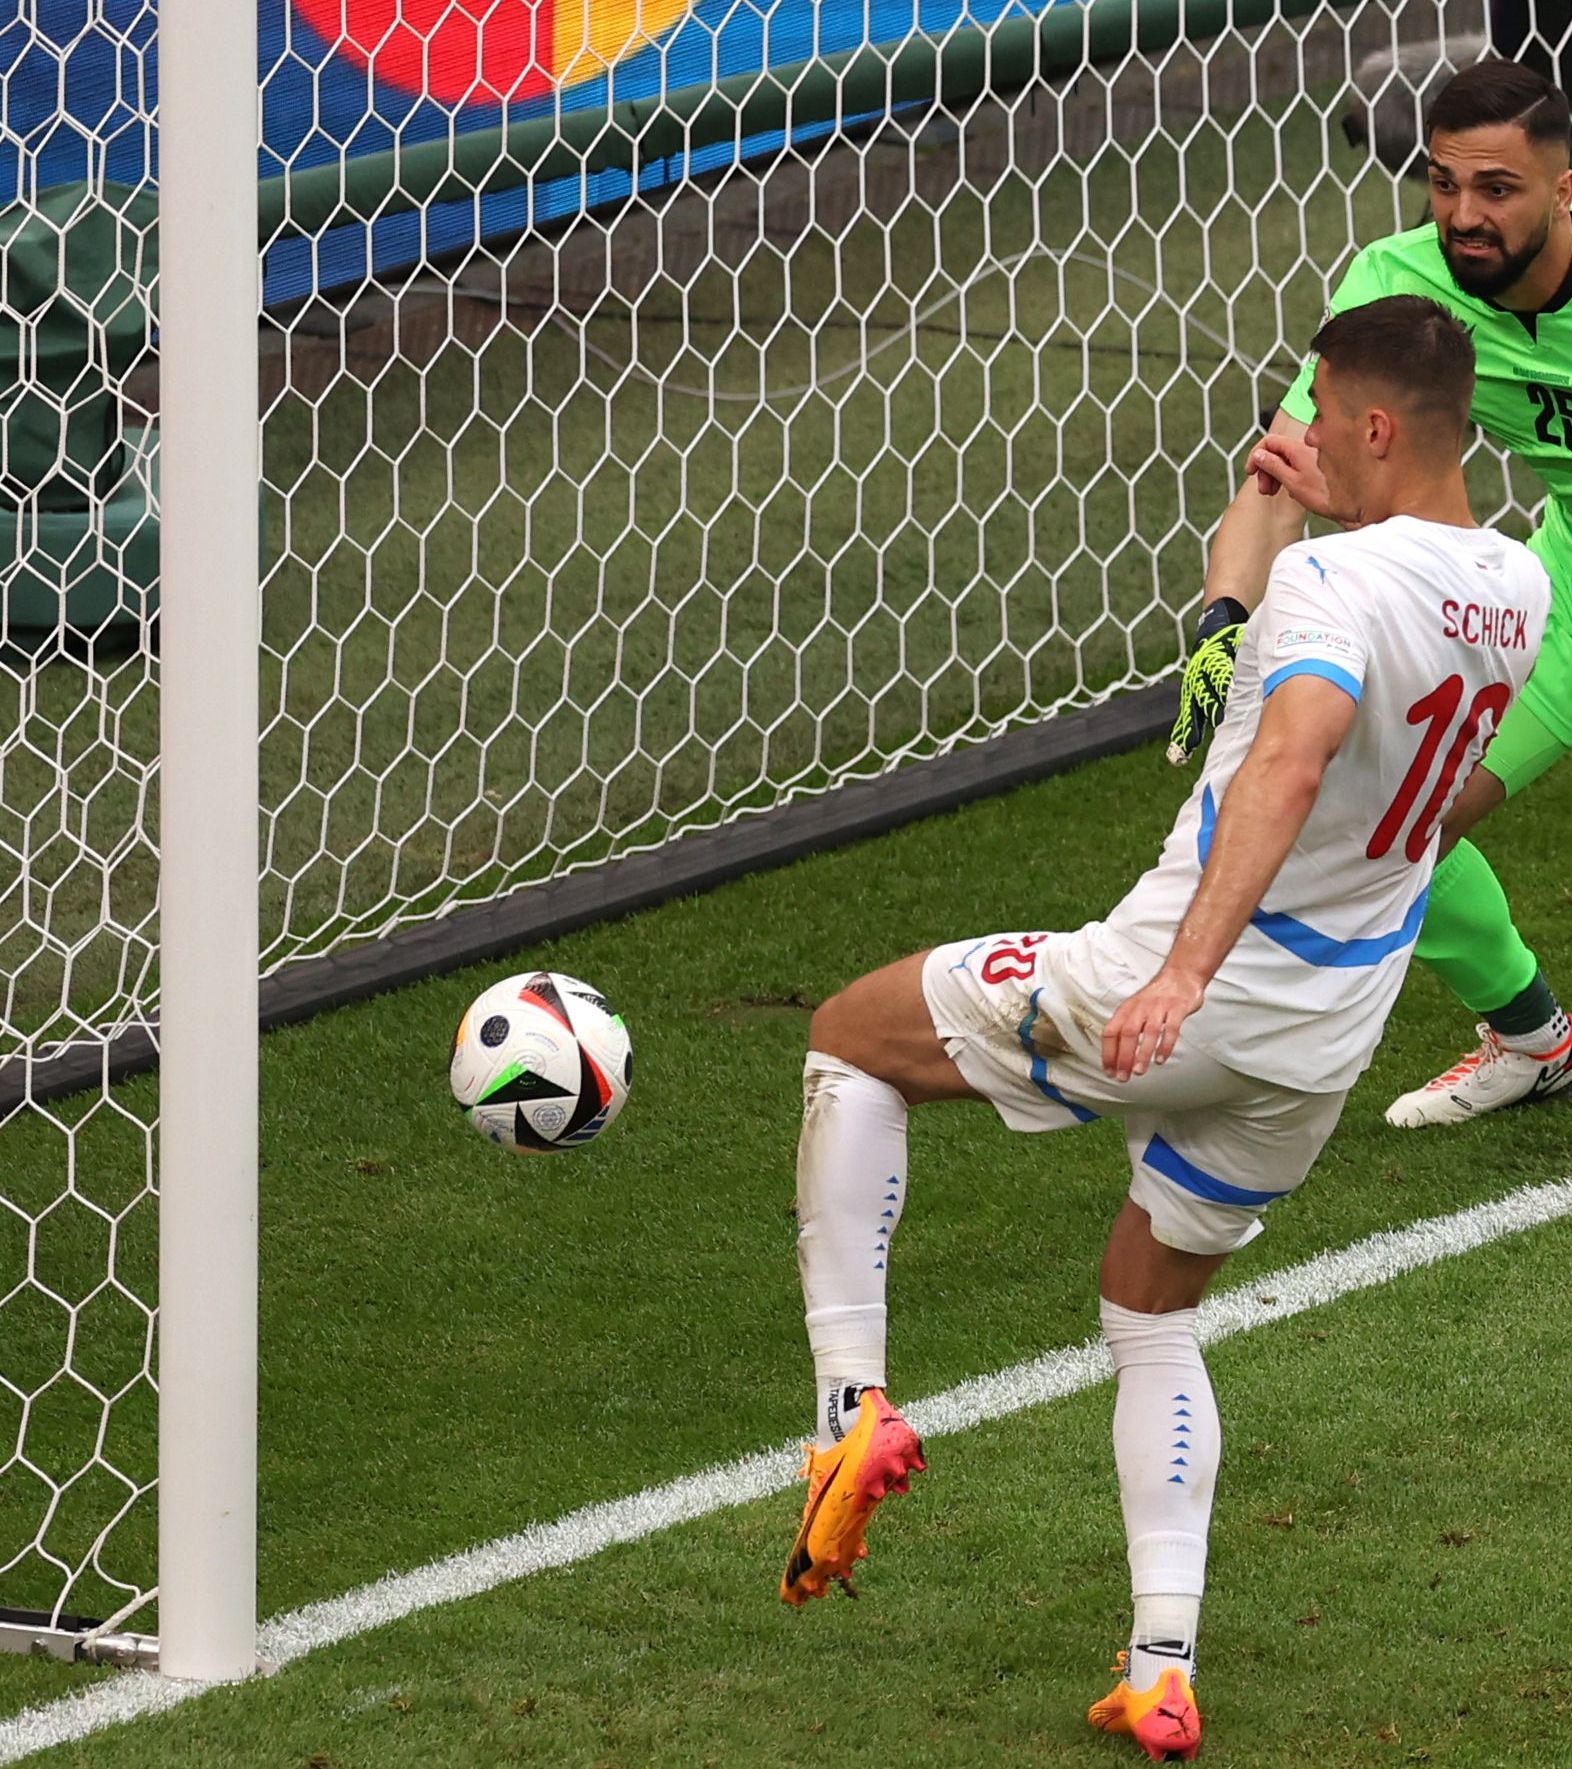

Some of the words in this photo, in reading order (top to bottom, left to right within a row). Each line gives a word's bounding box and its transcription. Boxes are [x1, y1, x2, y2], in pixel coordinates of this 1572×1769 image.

[1276, 631, 1351, 648] FOUNDATION
[1441, 599, 1529, 651] SCHICK
[1366, 673, 1511, 863] 10
